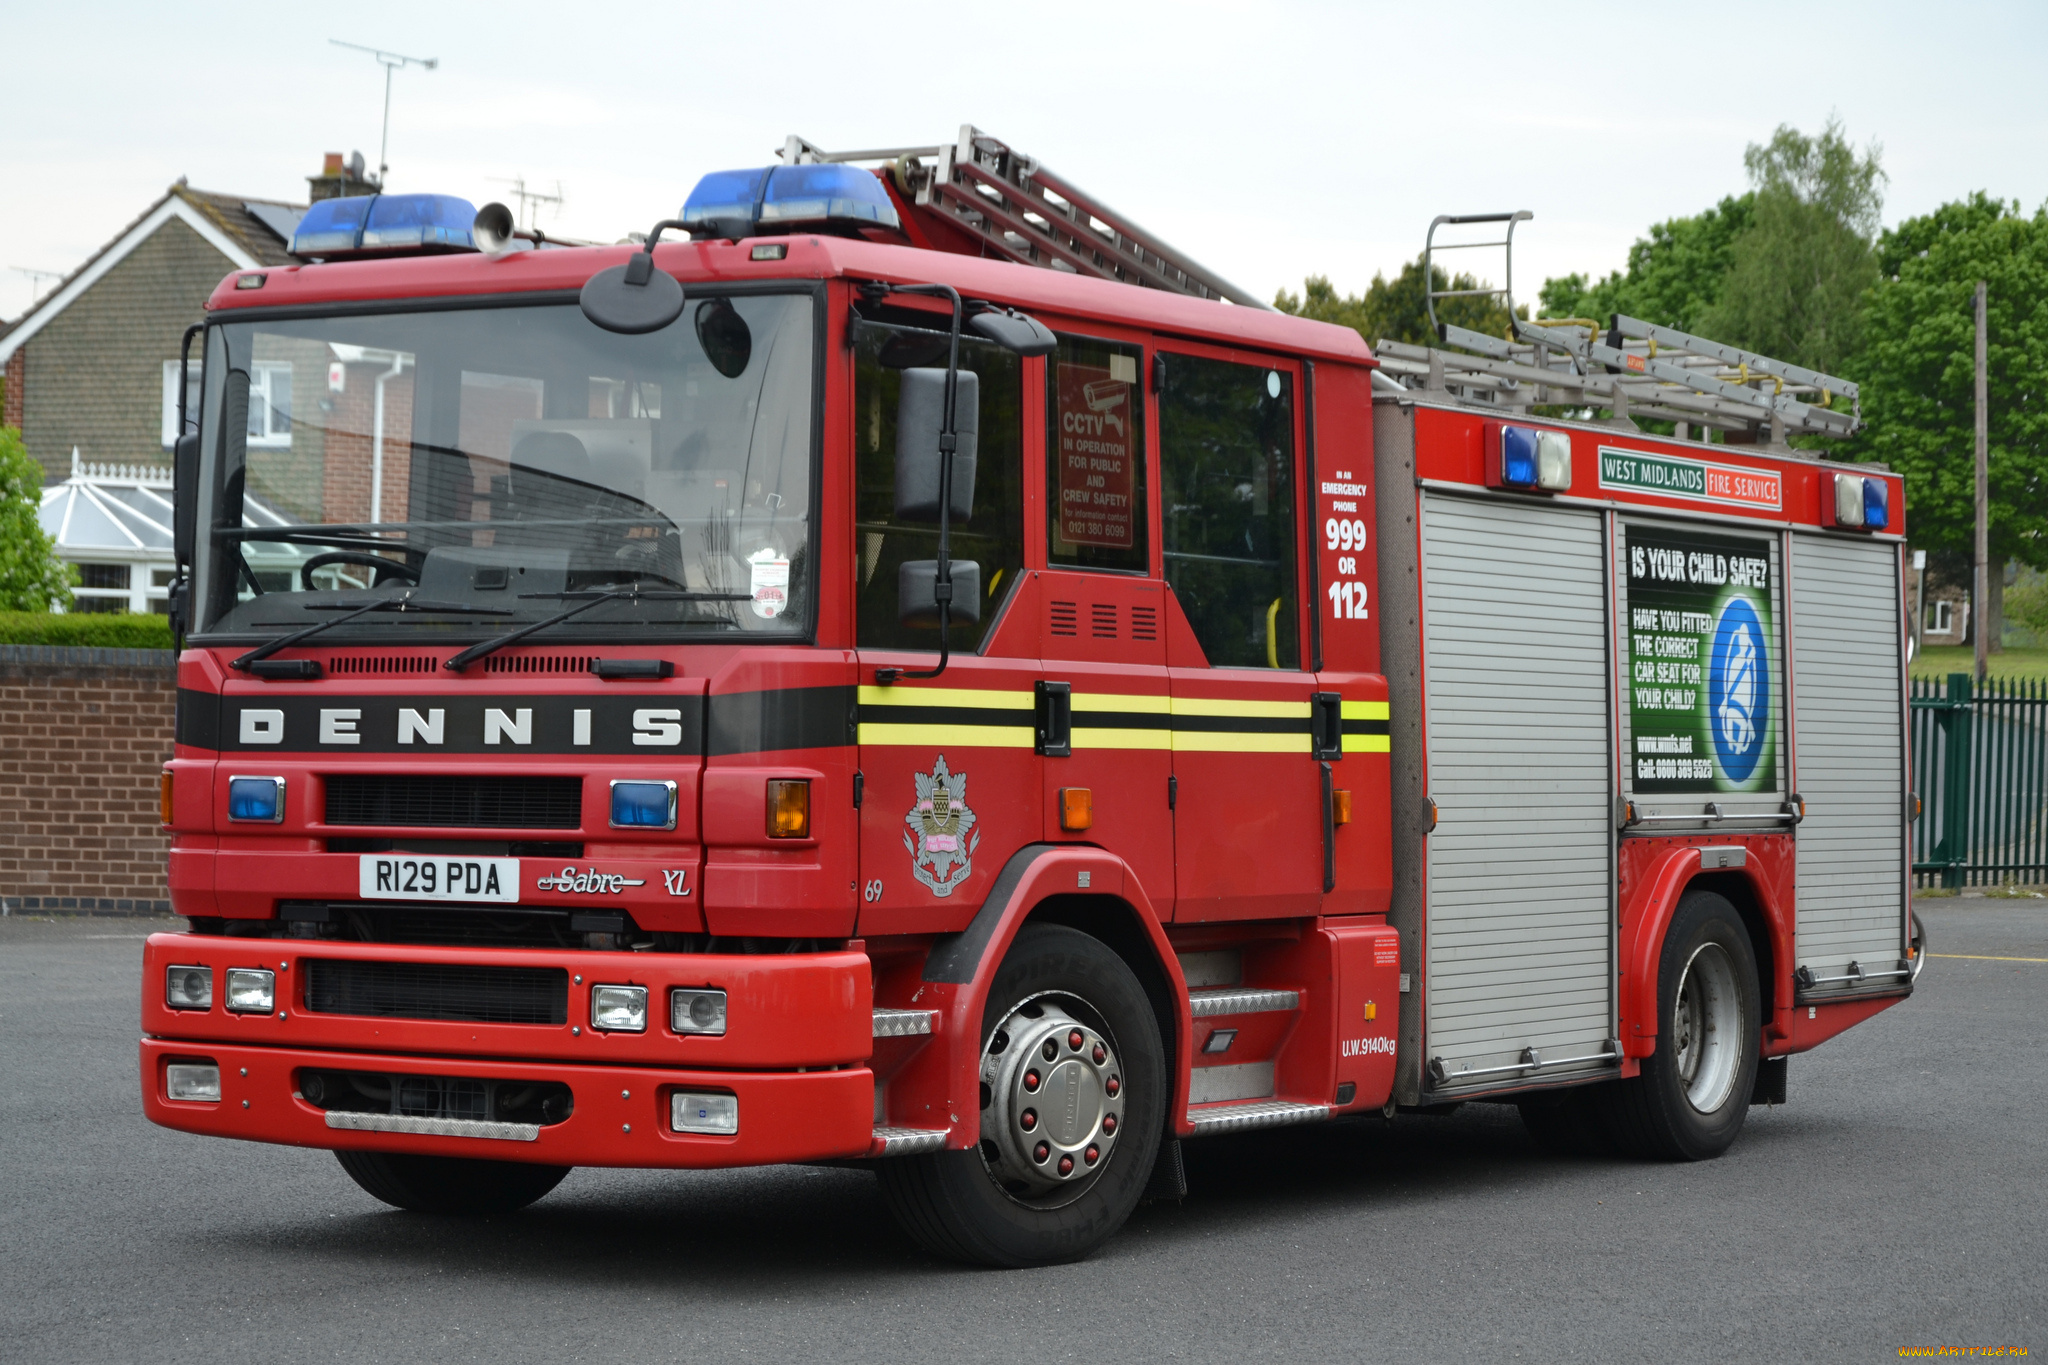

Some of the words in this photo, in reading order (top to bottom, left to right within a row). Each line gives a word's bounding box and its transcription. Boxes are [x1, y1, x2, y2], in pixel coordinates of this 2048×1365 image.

[1063, 411, 1104, 436] CCTV
[1063, 437, 1073, 450] IN
[1076, 438, 1125, 457] OPERATION
[1068, 455, 1087, 469] FOR
[1090, 458, 1122, 474] PUBLIC
[1336, 471, 1343, 479] IN
[1343, 471, 1352, 480] AN
[1086, 474, 1105, 488] AND
[1321, 482, 1367, 497] EMERGENCY
[1604, 458, 1637, 482] WEST
[1641, 463, 1703, 491] MIDLANDS
[1709, 473, 1731, 494] FIRE
[1734, 477, 1778, 500] SERVICE
[1063, 488, 1090, 503] CREW
[1093, 491, 1128, 508] SAFETY
[1333, 500, 1357, 513] PHONE
[1075, 508, 1106, 520] information
[1107, 513, 1128, 523] contact
[1068, 521, 1085, 534] 0121
[1088, 522, 1103, 536] 380
[1105, 524, 1125, 538] 6099
[1325, 518, 1367, 552] 999
[1338, 556, 1357, 575] OR
[1631, 546, 1646, 579] IS
[1647, 548, 1686, 582] YOUR
[1688, 552, 1727, 585] CHILD
[1729, 556, 1768, 589] SAFE?
[1328, 581, 1369, 619] 112
[1633, 608, 1659, 631] HAVE
[1659, 609, 1680, 632] YOU
[1681, 611, 1713, 634] FITTED
[1633, 634, 1653, 657] THE
[1655, 635, 1699, 659] CORRECT
[1634, 661, 1655, 683] CAR
[1656, 662, 1680, 684] SEAT
[1682, 663, 1701, 685] FOR
[1635, 687, 1662, 710] YOUR
[1663, 688, 1696, 711] CHILD?
[239, 708, 682, 746] DENNIS
[1637, 734, 1693, 754] www.wmfs.net
[1637, 758, 1656, 779] Call:
[1656, 759, 1676, 779] 0800
[1693, 759, 1713, 779] 5525
[376, 860, 436, 893] R129
[446, 862, 501, 895] PDA
[558, 866, 625, 894] Sabre
[662, 869, 691, 896] XL
[865, 879, 883, 903] 69
[1342, 1036, 1396, 1057] U.W.9140kg
